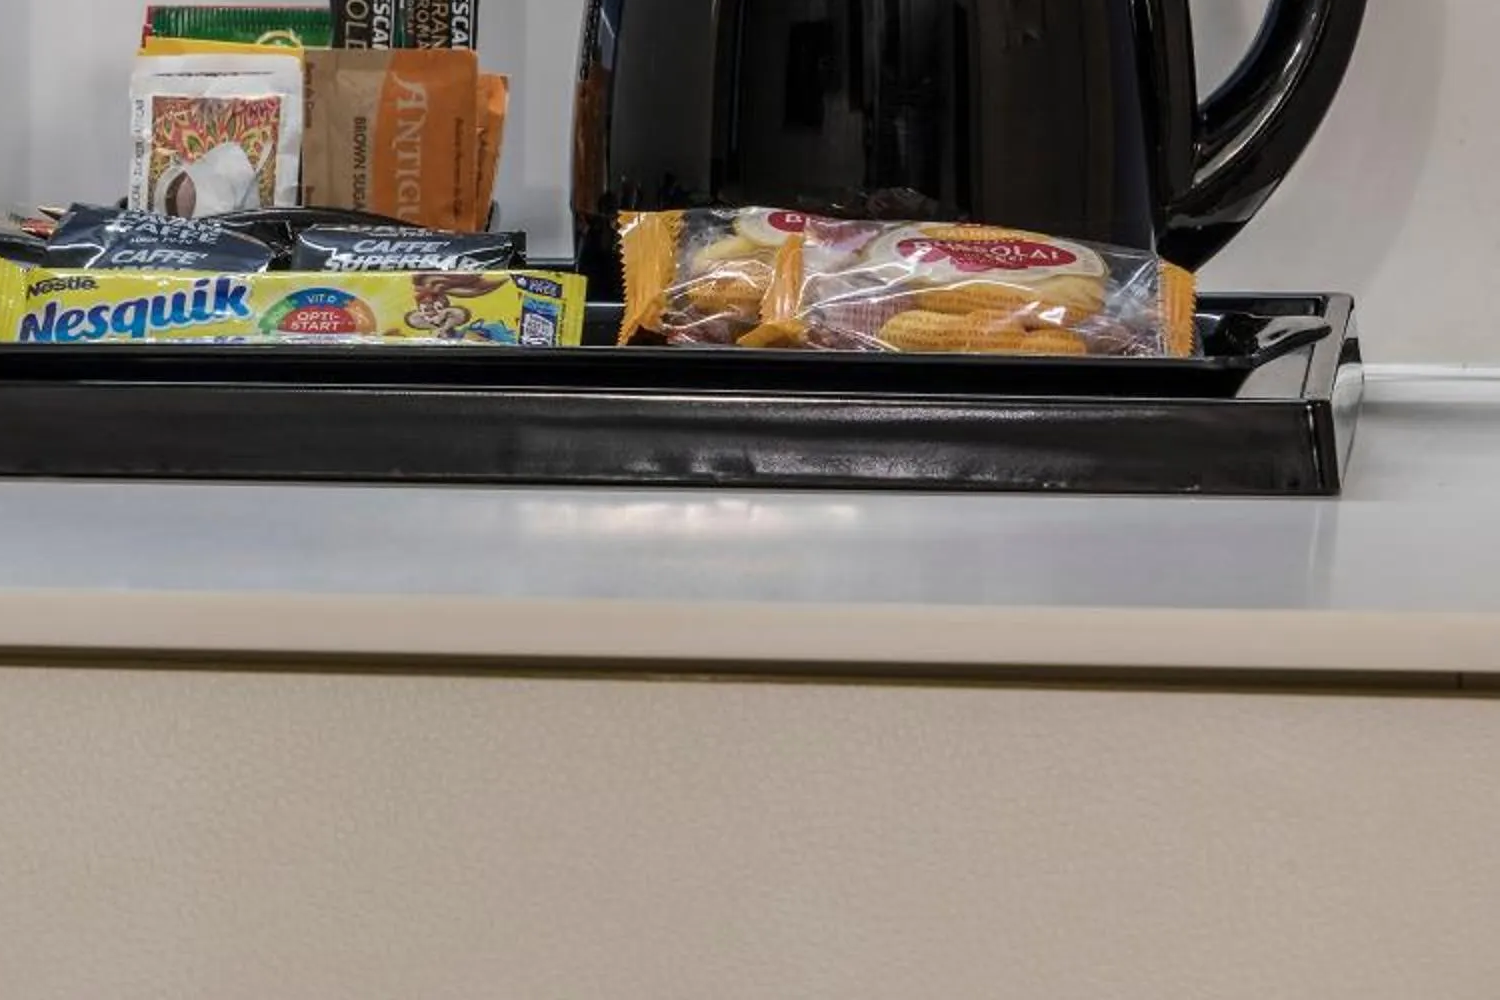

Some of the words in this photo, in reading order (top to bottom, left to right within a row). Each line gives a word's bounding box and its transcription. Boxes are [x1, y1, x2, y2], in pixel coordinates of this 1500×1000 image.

[352, 116, 367, 170] BROWN
[19, 277, 252, 343] Nesquik
[290, 321, 341, 331] START
[296, 311, 341, 322] OPTI-
